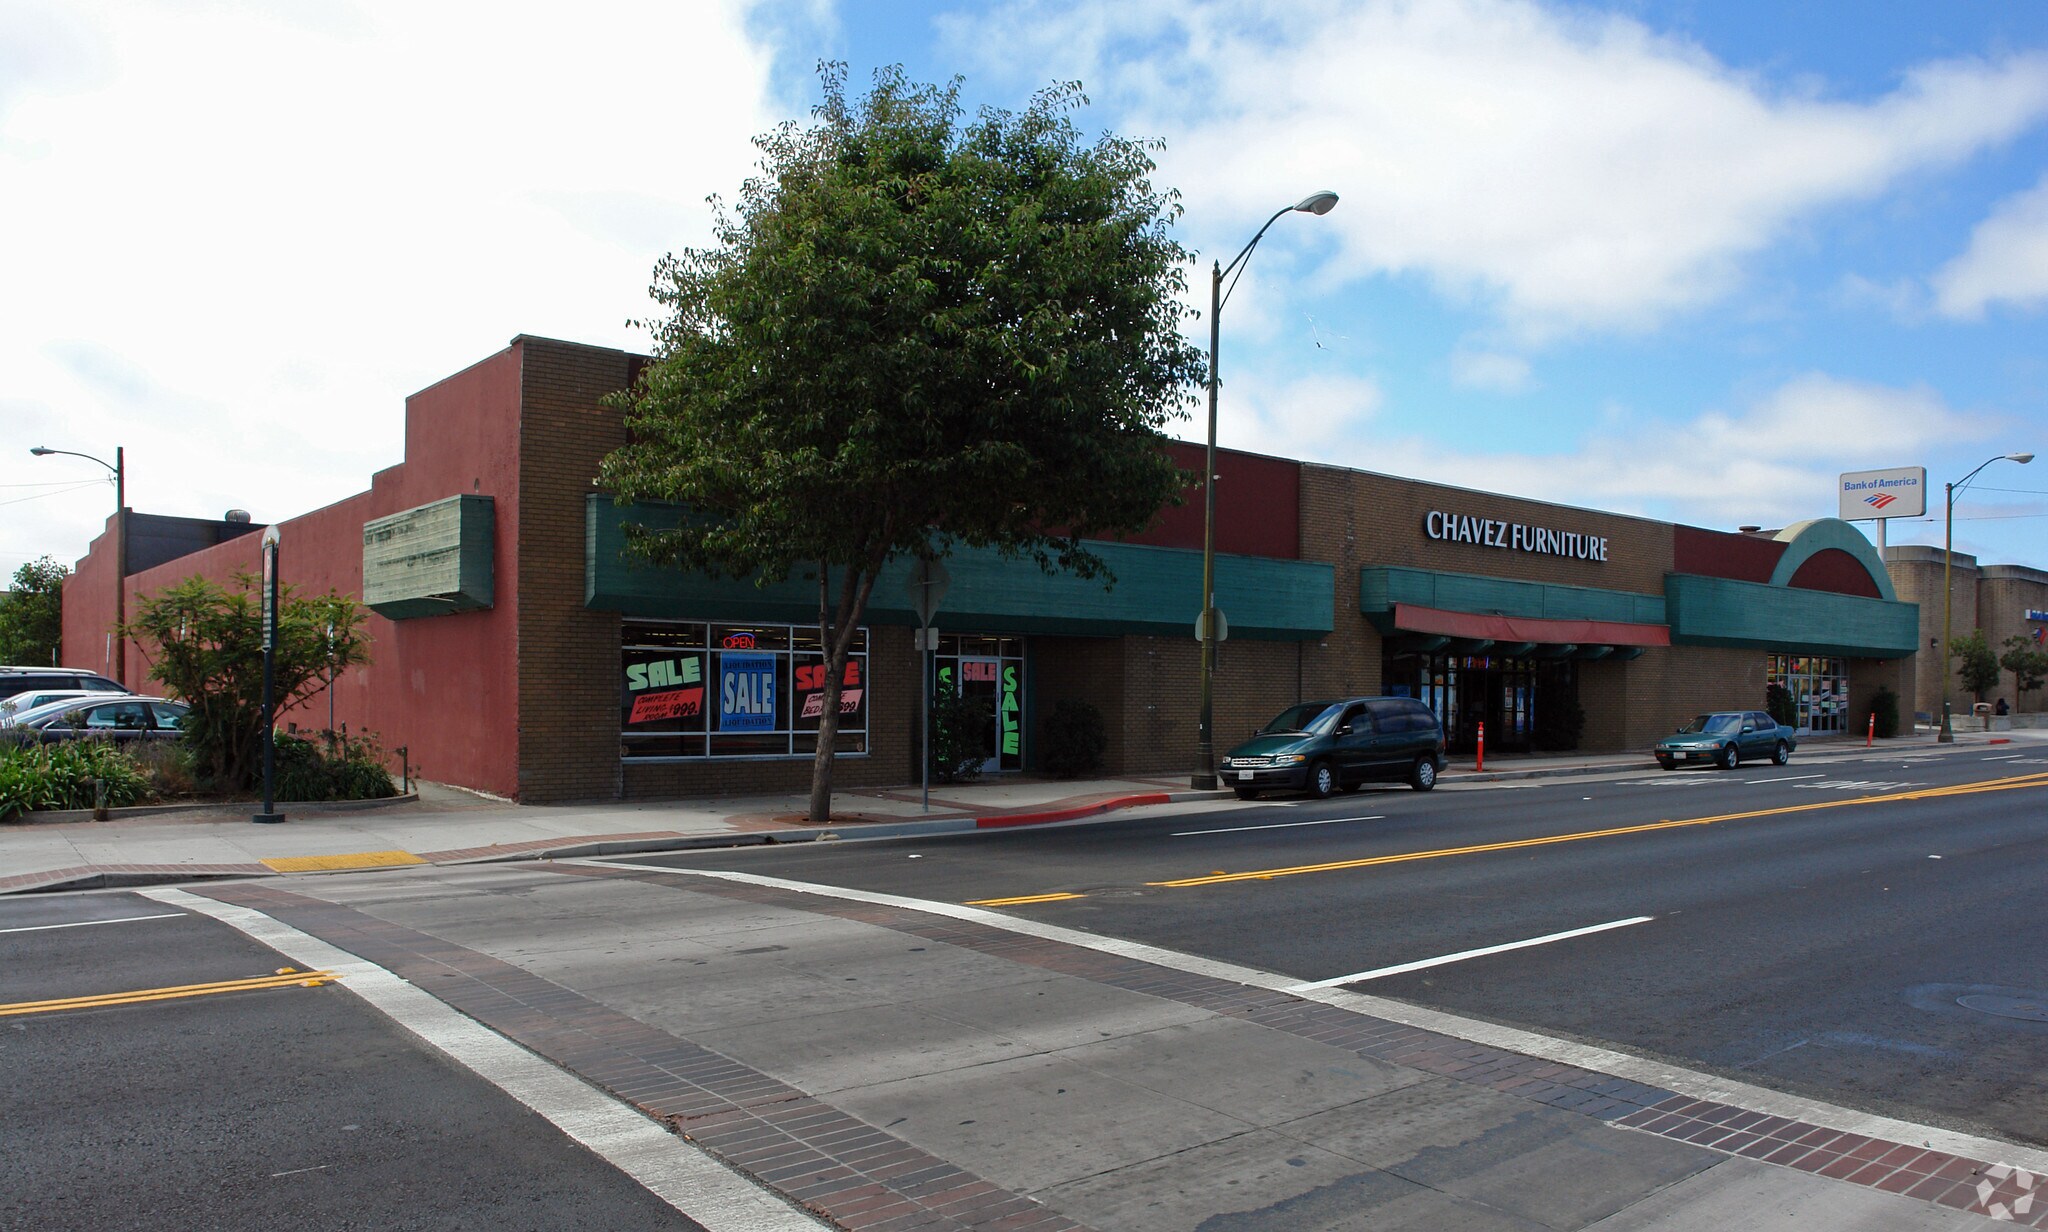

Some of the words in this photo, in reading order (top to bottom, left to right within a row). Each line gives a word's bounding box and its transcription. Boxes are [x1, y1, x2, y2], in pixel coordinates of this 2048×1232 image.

[1844, 480, 1867, 491] Bank
[1867, 479, 1878, 489] of
[1878, 477, 1917, 488] America
[1426, 510, 1507, 548] CHAVEZ
[1511, 523, 1608, 562] FURNITURE
[723, 636, 755, 649] OPEN
[626, 656, 702, 691] SALE
[724, 661, 773, 670] LIQUIDATION
[963, 662, 996, 681] SALE
[795, 661, 860, 690] SAE
[638, 692, 683, 705] COMPLETE
[723, 671, 773, 715] SALE
[636, 704, 667, 714] LIVING
[643, 711, 668, 721] ROOM
[1001, 666, 1020, 755] SALE
